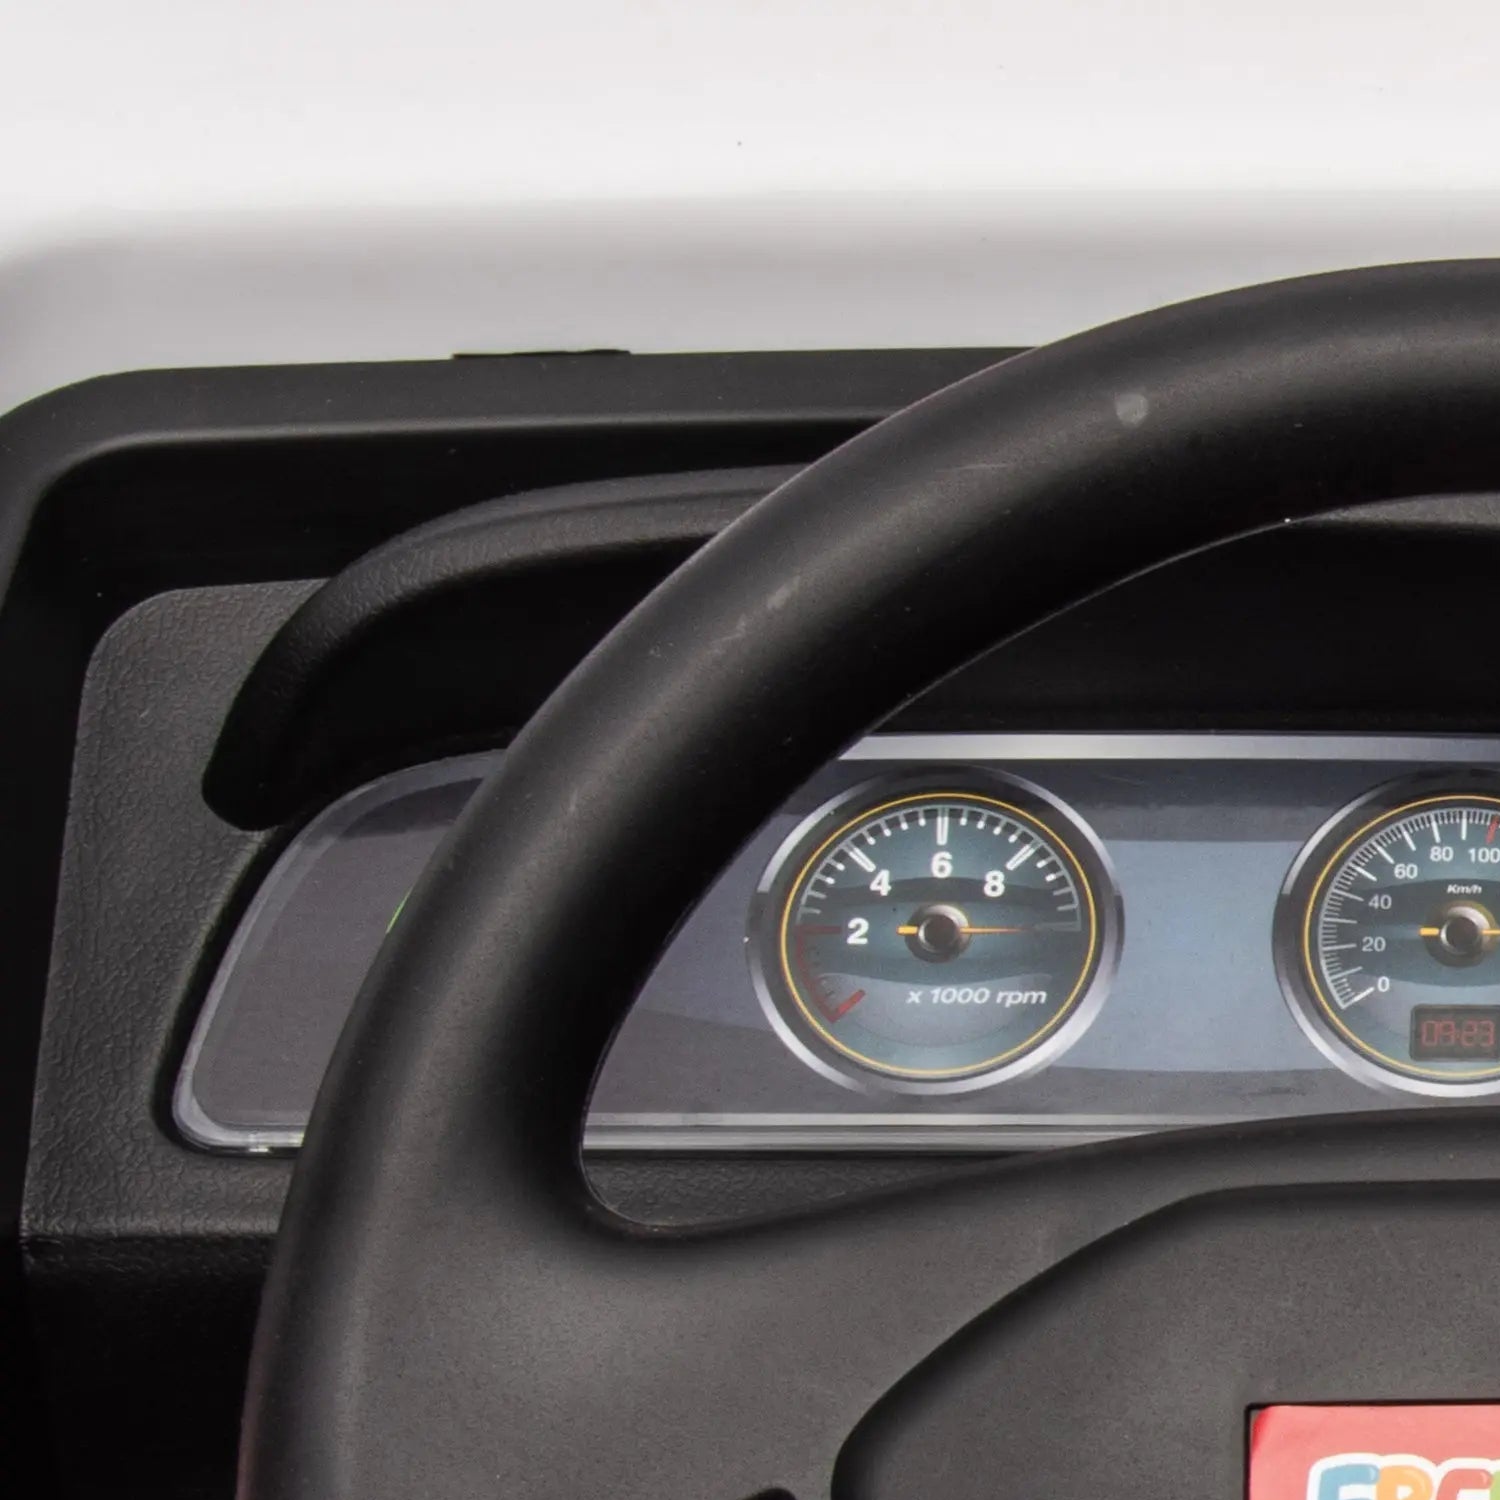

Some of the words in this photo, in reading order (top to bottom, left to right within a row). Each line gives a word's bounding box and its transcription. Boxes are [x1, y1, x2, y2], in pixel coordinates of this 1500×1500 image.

[1430, 847, 1453, 862] 80
[1468, 848, 1500, 863] 100
[930, 851, 953, 877] 6
[1394, 864, 1418, 880] 60
[870, 870, 892, 896] 4
[983, 871, 1006, 897] 8
[1368, 895, 1392, 910] 40
[847, 918, 869, 945] 2
[1362, 937, 1386, 952] 20
[1377, 977, 1391, 993] 0
[907, 991, 924, 1004] x
[930, 987, 991, 1004] 1000
[995, 990, 1047, 1008] rpm
